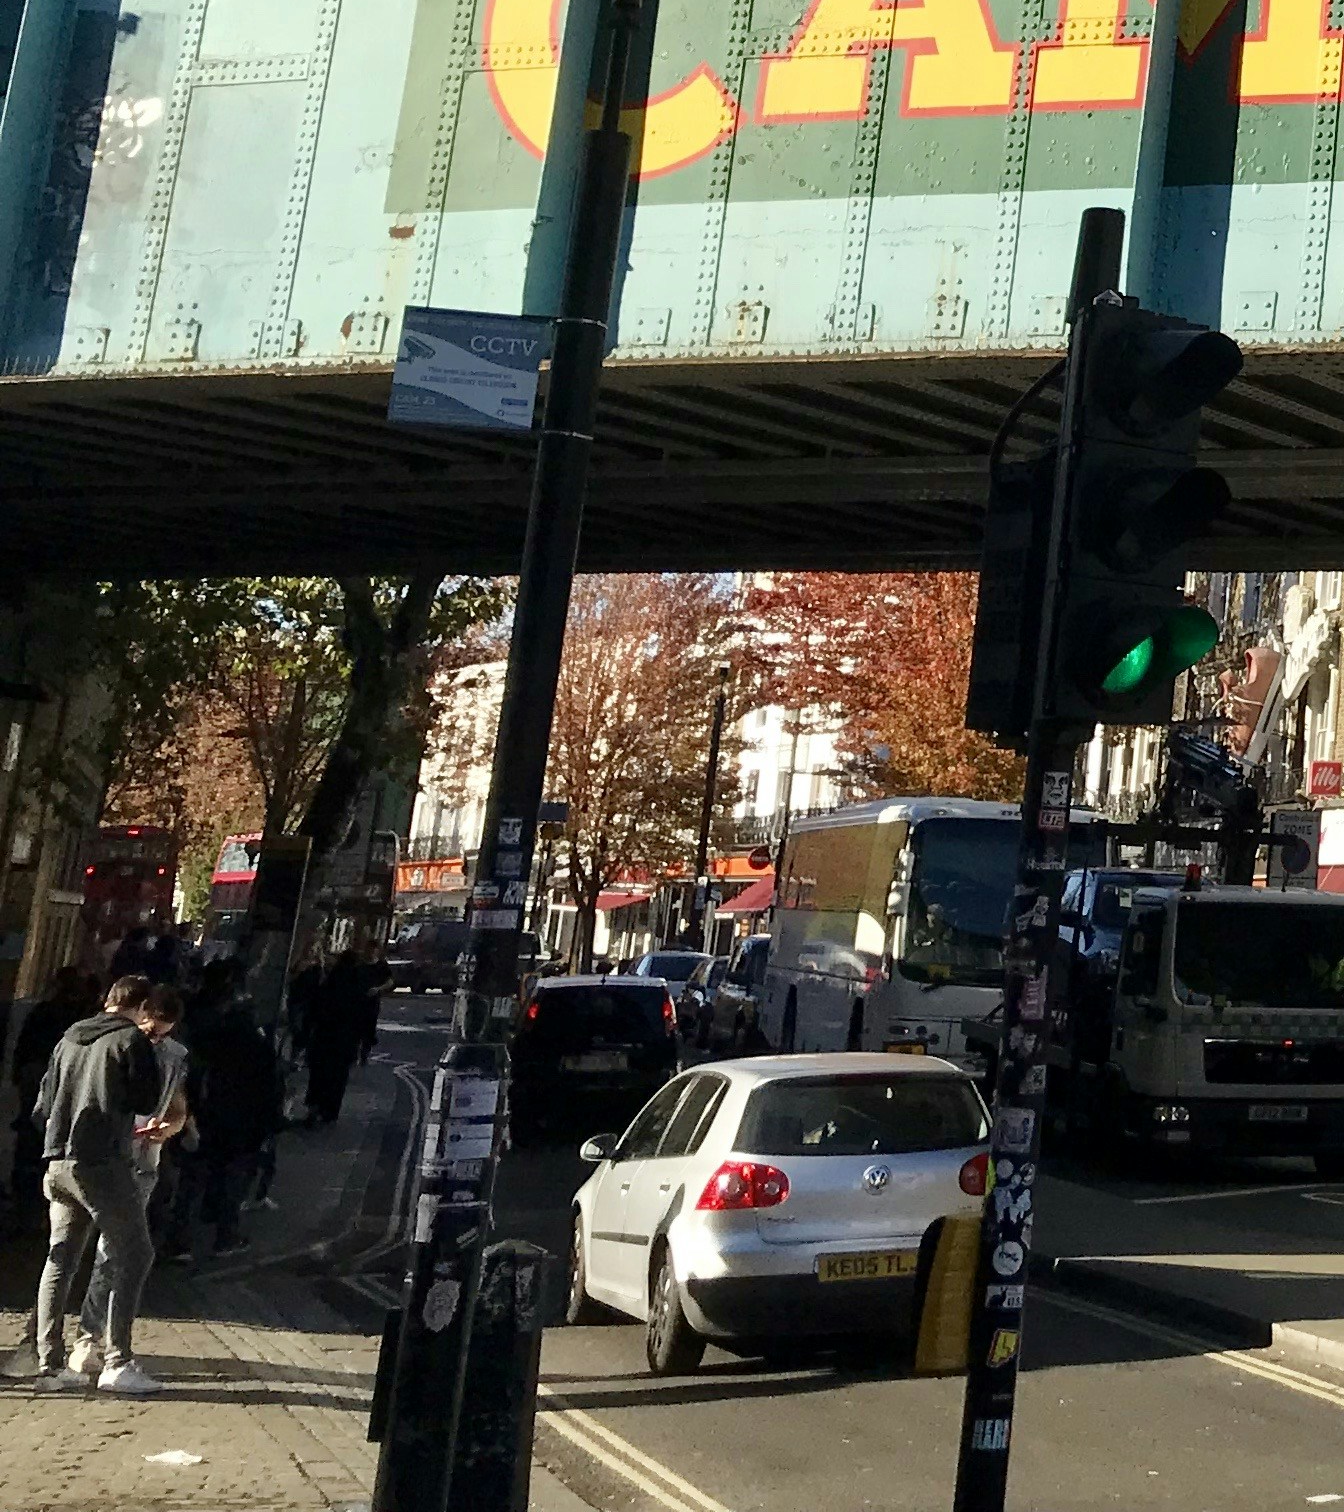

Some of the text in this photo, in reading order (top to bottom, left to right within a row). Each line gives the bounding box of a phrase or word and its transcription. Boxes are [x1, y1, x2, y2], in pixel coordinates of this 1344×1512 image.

[470, 335, 538, 356] CCTV
[1313, 766, 1341, 791] illy
[1283, 825, 1312, 836] ZONE
[884, 1254, 916, 1275] TL
